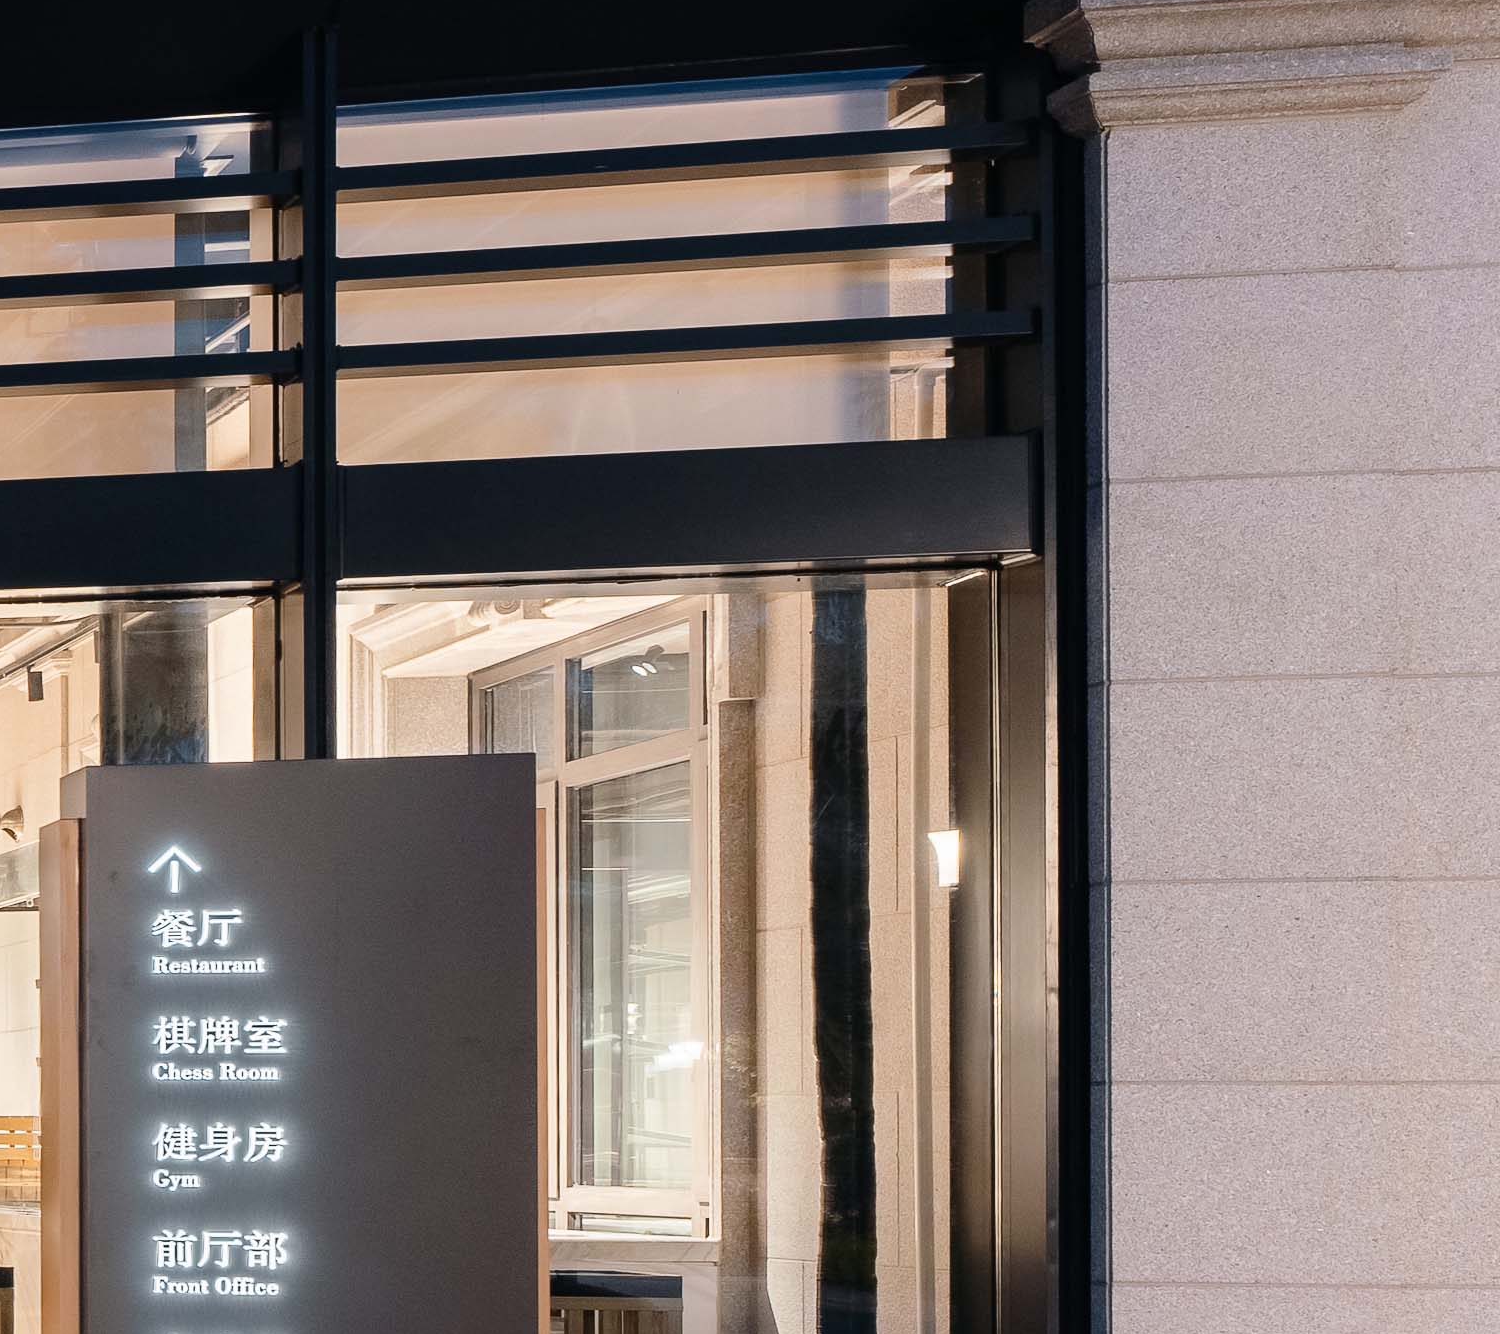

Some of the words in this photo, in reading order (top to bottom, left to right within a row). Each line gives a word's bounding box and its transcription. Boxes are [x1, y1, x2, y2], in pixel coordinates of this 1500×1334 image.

[151, 909, 243, 948] 餐厅
[152, 956, 266, 974] Restaurant
[153, 1016, 288, 1055] 棋牌室
[153, 1062, 214, 1082] Chess
[219, 1062, 280, 1082] Room
[153, 1122, 288, 1163] 健身房
[153, 1169, 201, 1191] Gym
[152, 1229, 289, 1270] 前厅部
[153, 1275, 210, 1296] Front
[215, 1276, 280, 1297] Office
